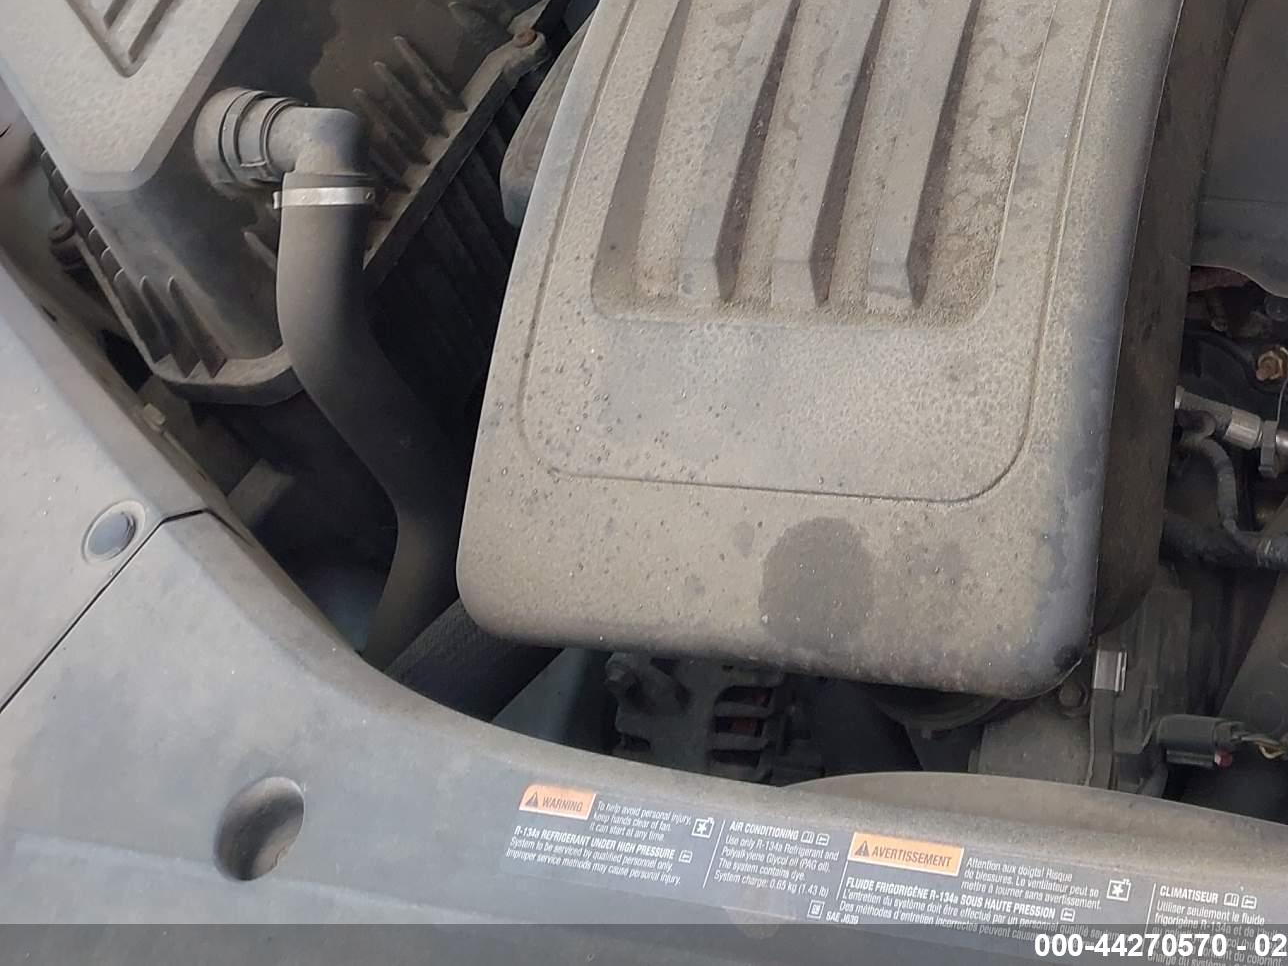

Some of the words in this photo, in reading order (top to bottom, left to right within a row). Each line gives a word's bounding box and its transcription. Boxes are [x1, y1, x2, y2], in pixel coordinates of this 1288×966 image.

[542, 796, 584, 812] WARNING
[606, 802, 621, 813] help
[621, 804, 641, 815] avoid
[640, 808, 672, 820] personal
[596, 824, 609, 832] can
[609, 825, 626, 835] start
[626, 828, 634, 836] at
[635, 830, 648, 840] any
[611, 813, 631, 824] hands
[632, 817, 650, 827] clear
[650, 819, 660, 829] of
[729, 820, 744, 831] AIR
[744, 822, 799, 840] CONDITIONING
[510, 837, 535, 850] System
[535, 841, 544, 850] to
[544, 842, 553, 851] be
[553, 845, 583, 856] serviced
[583, 849, 592, 859] by
[592, 849, 623, 863] qualified
[621, 856, 658, 868] personnel
[514, 825, 540, 838] R-134a
[541, 830, 591, 845] REFRIGERANT
[591, 837, 617, 849] UNDER
[616, 841, 636, 853] HIGH
[636, 844, 676, 859] PRESSURE
[726, 834, 739, 845] Use
[740, 837, 756, 849] only
[756, 839, 783, 852] R-134a
[784, 843, 824, 858] Refrigerant
[825, 849, 840, 860] and
[506, 848, 537, 862] Improper
[537, 854, 561, 864] service
[562, 858, 591, 870] methods
[592, 864, 608, 874] may
[608, 866, 629, 875] cause
[629, 869, 660, 881] personal
[719, 857, 732, 868] The
[732, 862, 759, 873] system
[760, 866, 790, 877] contains
[721, 846, 766, 861] Polyalkylene
[766, 853, 789, 865] Glycol
[789, 857, 799, 866] oil
[800, 858, 818, 870] (PAG
[871, 846, 952, 867] AVERTISSEMENT
[966, 857, 1001, 871] Attention
[1002, 864, 1016, 873] aux
[1018, 865, 1044, 878] doigts!
[1046, 867, 1073, 882] Risque
[714, 869, 741, 883] System
[769, 878, 787, 889] 0.65
[787, 881, 798, 893] kg
[798, 882, 818, 895] (1.43
[818, 886, 830, 898] lb)
[961, 880, 987, 892] mettre
[995, 884, 1024, 897] tourner
[1025, 890, 1043, 900] sans
[1045, 892, 1102, 909] avertissement.
[964, 868, 974, 878] de
[976, 870, 1014, 884] blessures.
[1016, 876, 1026, 886] Le
[1028, 878, 1069, 892] ventilateur
[1069, 884, 1088, 895] peut
[1090, 888, 1099, 897] se
[1160, 886, 1219, 903] CLIMATISEUR
[846, 877, 875, 890] FLUIDE
[929, 890, 959, 903] R-134a
[960, 894, 984, 907] SOUS
[984, 898, 1012, 912] HAUTE
[1013, 902, 1056, 919] PRESSION
[826, 911, 841, 923] SAE
[841, 914, 859, 925] J639
[840, 900, 854, 911] Des
[935, 917, 977, 931] incorrectes
[977, 924, 1011, 938] peuvent
[842, 889, 881, 903] L'entretien
[882, 896, 893, 905] du
[926, 903, 942, 913] doit
[991, 914, 1005, 923] par
[1007, 916, 1018, 925] un
[1019, 918, 1059, 932] personnel
[1157, 901, 1186, 914] Utiliser
[1186, 905, 1230, 920] seulement
[1232, 911, 1240, 921] le
[1241, 913, 1265, 924] fluide
[1200, 920, 1231, 933] R-134a
[1233, 926, 1242, 935] et
[1245, 927, 1255, 937] de
